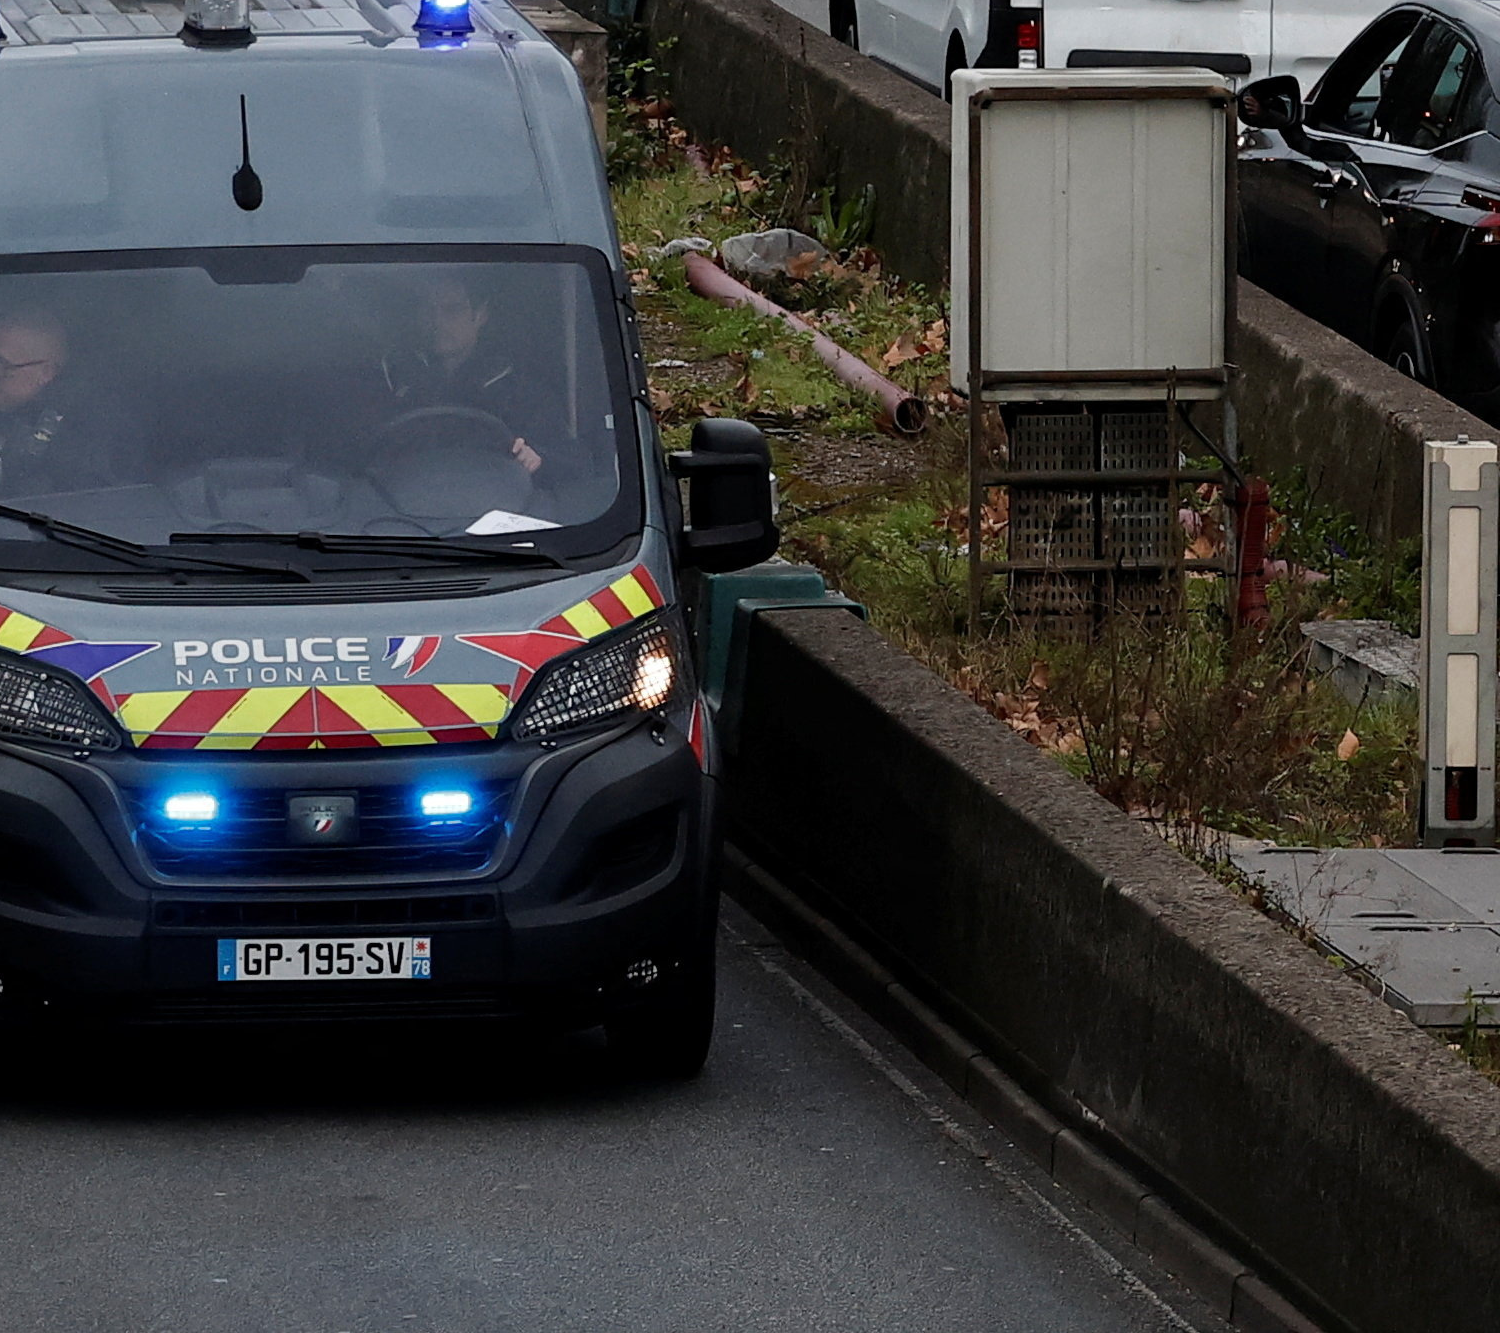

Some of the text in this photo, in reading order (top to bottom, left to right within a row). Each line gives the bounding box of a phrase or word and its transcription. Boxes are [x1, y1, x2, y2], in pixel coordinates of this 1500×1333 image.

[173, 636, 372, 666] POLICE
[176, 666, 373, 686] NATIONALE
[243, 941, 406, 976] GP-195-SV
[412, 960, 430, 976] 78
